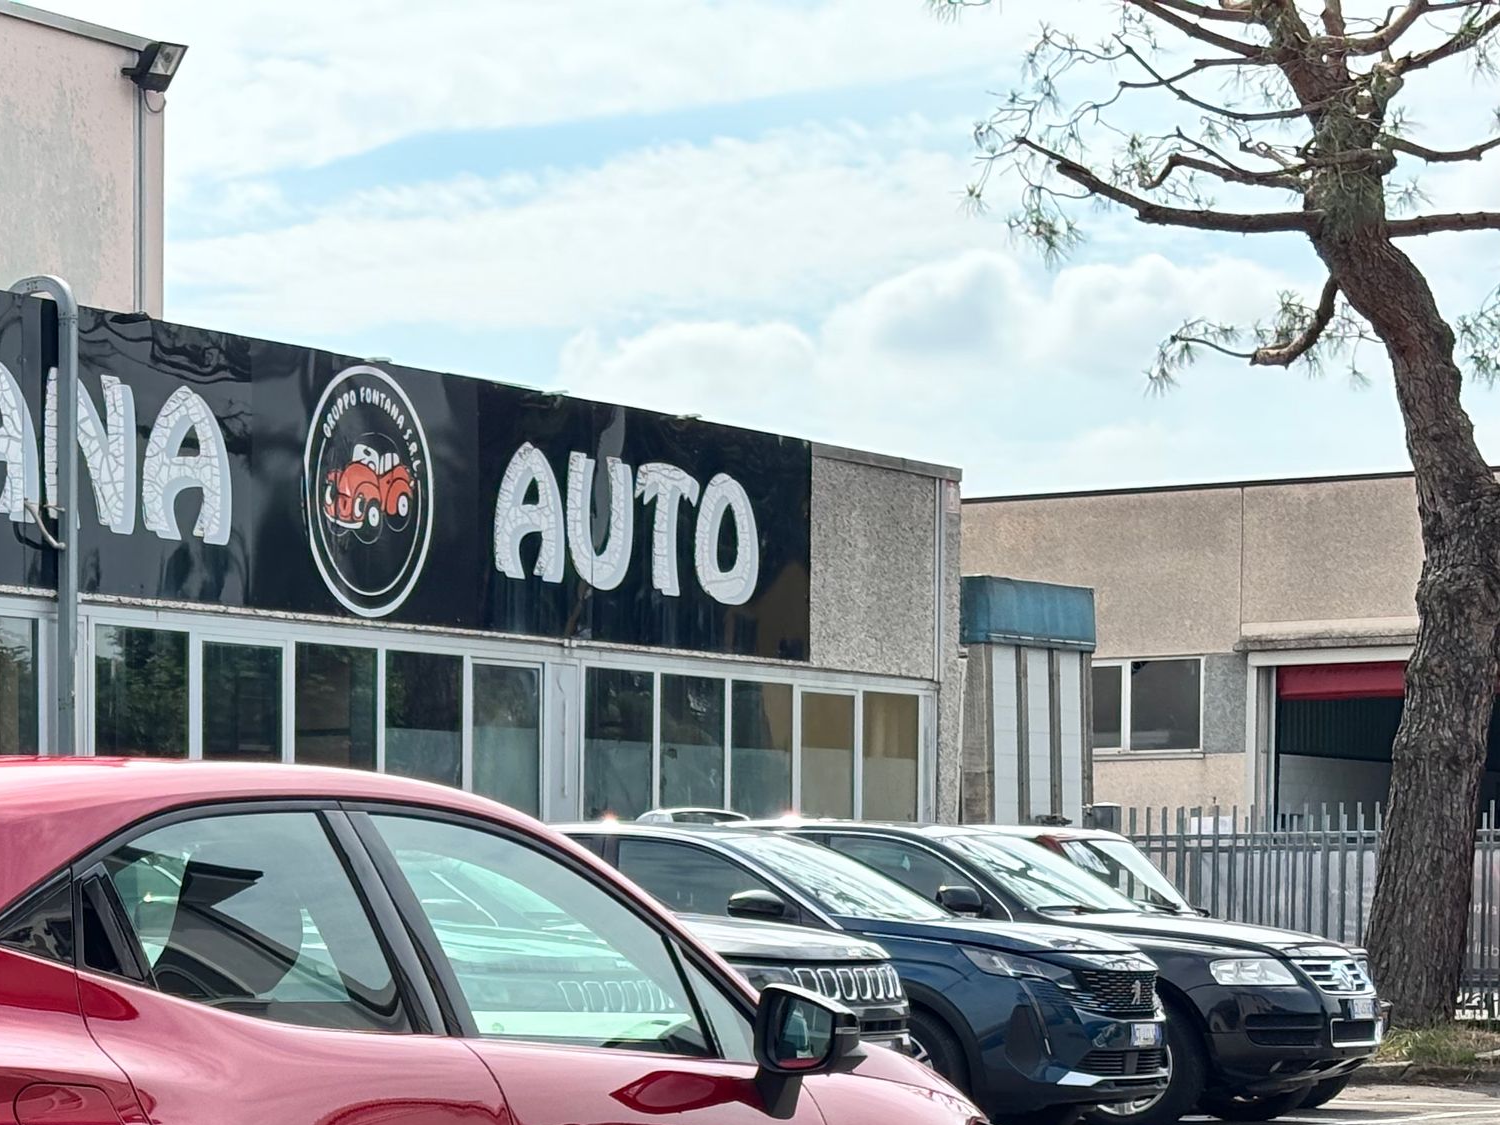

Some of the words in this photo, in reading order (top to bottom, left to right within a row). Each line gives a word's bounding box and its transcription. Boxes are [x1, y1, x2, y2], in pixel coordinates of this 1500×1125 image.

[323, 389, 357, 438] GRUPPO
[360, 386, 405, 429] FONTANA
[493, 441, 760, 606] AUTO
